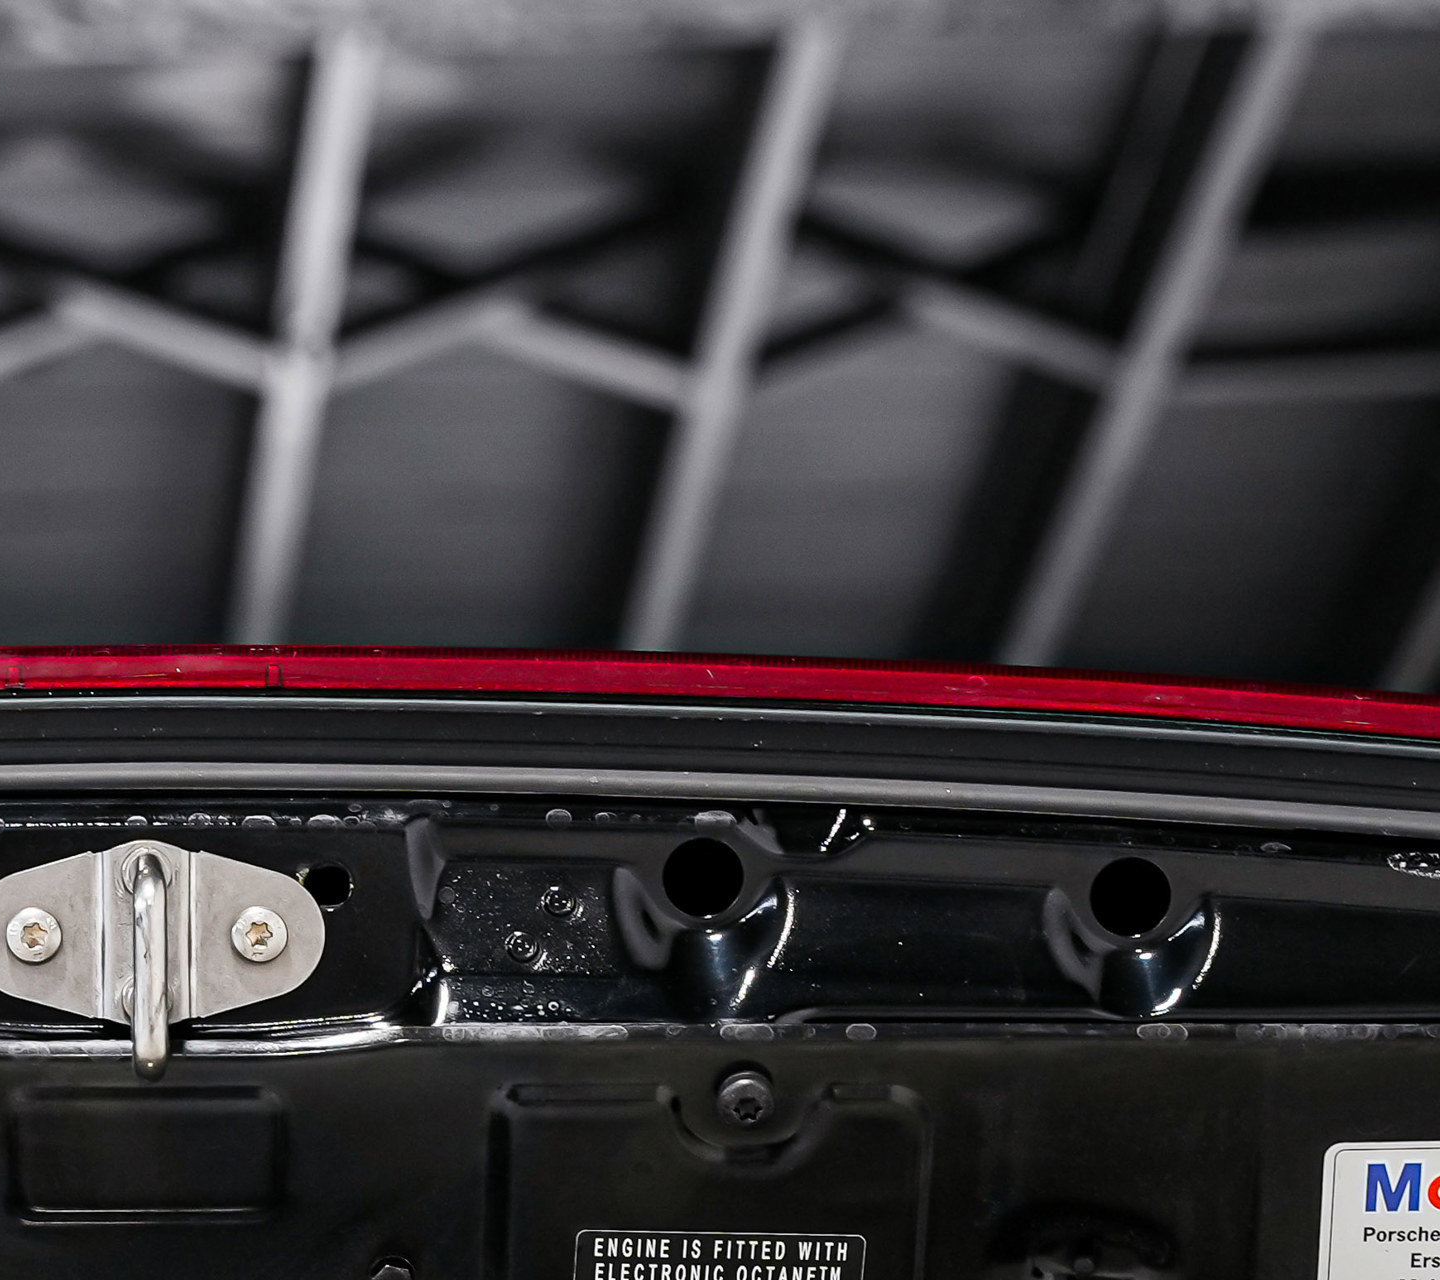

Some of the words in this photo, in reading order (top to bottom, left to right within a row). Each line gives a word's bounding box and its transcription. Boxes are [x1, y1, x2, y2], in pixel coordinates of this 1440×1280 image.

[1364, 1227, 1440, 1242] Porsche
[595, 1238, 670, 1257] ENGINE
[683, 1240, 701, 1258] IS
[714, 1240, 785, 1259] FITTED
[799, 1242, 847, 1261] WITH
